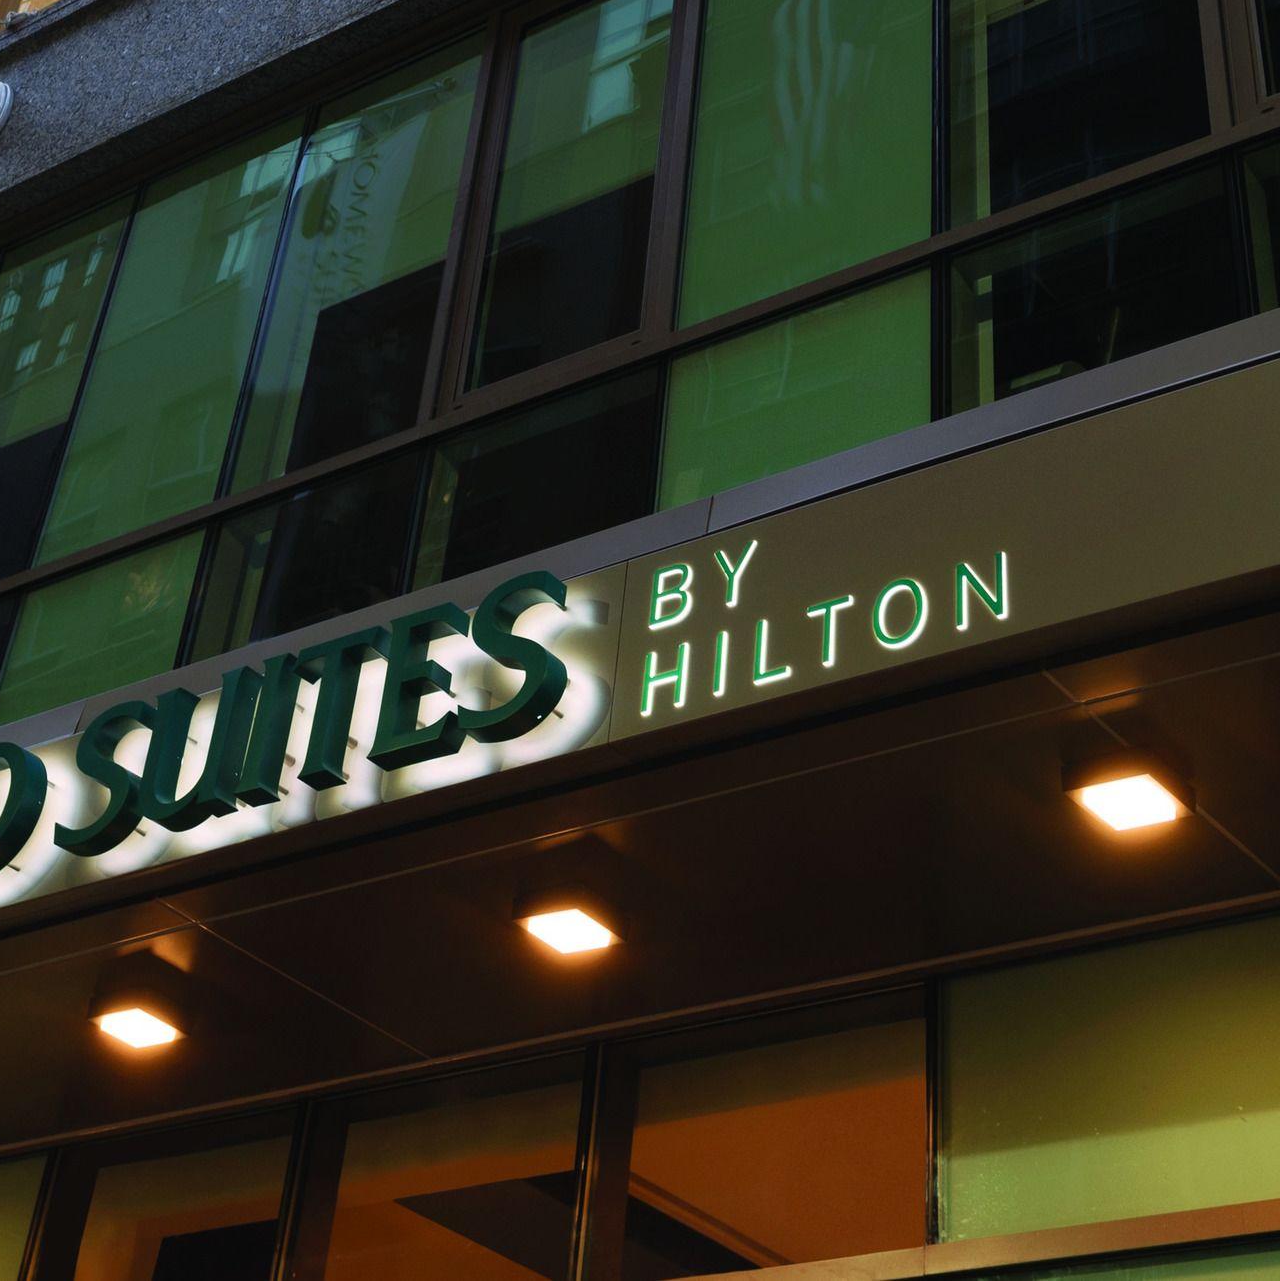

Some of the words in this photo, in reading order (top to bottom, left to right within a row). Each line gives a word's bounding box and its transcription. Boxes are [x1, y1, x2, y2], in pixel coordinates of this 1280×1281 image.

[639, 550, 1009, 718] HILTON
[647, 538, 759, 631] BY
[54, 569, 569, 858] SUITES
